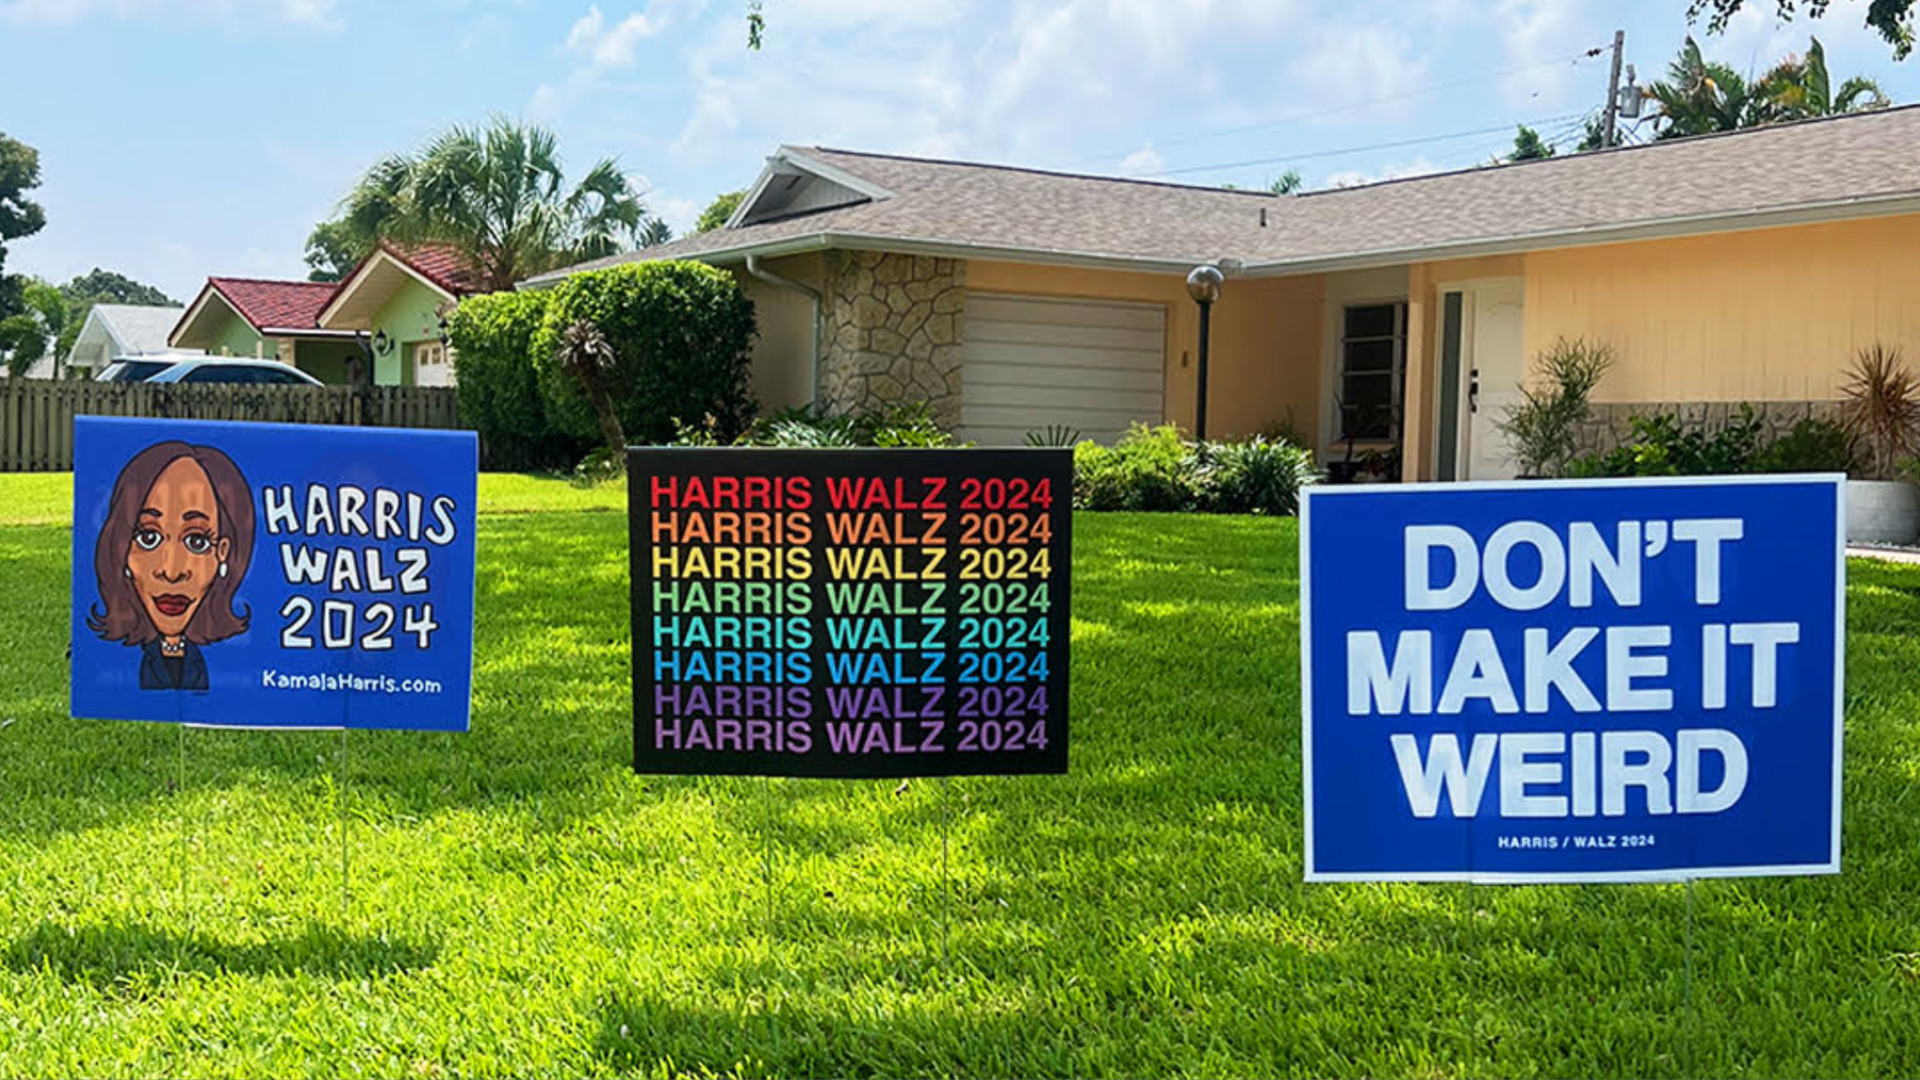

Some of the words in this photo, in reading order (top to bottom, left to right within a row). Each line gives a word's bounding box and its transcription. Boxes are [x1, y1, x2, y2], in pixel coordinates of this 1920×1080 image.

[651, 476, 812, 510] HARRIS
[826, 477, 947, 509] WALZ
[960, 478, 1053, 510] 2024
[265, 484, 456, 545] HARRIS
[652, 511, 812, 545] HARRIS
[826, 512, 947, 545] WALZ
[960, 513, 1052, 545] 2024
[281, 543, 429, 593] WALZ
[652, 546, 812, 580] HARRIS
[826, 547, 946, 580] WALZ
[960, 548, 1051, 579] 2024
[1405, 519, 1743, 610] DON'T
[653, 581, 812, 615] HARRIS
[826, 582, 946, 614] WALZ
[959, 582, 1051, 614] 2024
[281, 596, 438, 649] 2024
[654, 616, 812, 649] HARRIS
[826, 617, 946, 649] WALZ
[959, 617, 1050, 648] 2024
[262, 669, 442, 693] KamalaHarris.com
[654, 650, 812, 684] HARRIS
[826, 652, 946, 684] WALZ
[958, 651, 1049, 683] 2024
[1348, 626, 1672, 714] MAKE
[1703, 623, 1799, 708] IT
[655, 685, 812, 718] HARRIS
[826, 687, 945, 718] WALZ
[958, 686, 1048, 717] 2024
[656, 719, 812, 752] HARRIS
[826, 721, 944, 752] WALZ
[958, 720, 1048, 750] 2024
[1391, 729, 1748, 817] WEIRD
[1498, 836, 1558, 848] HARRIS
[1573, 835, 1616, 848] WALZ
[1621, 835, 1655, 847] 2024
